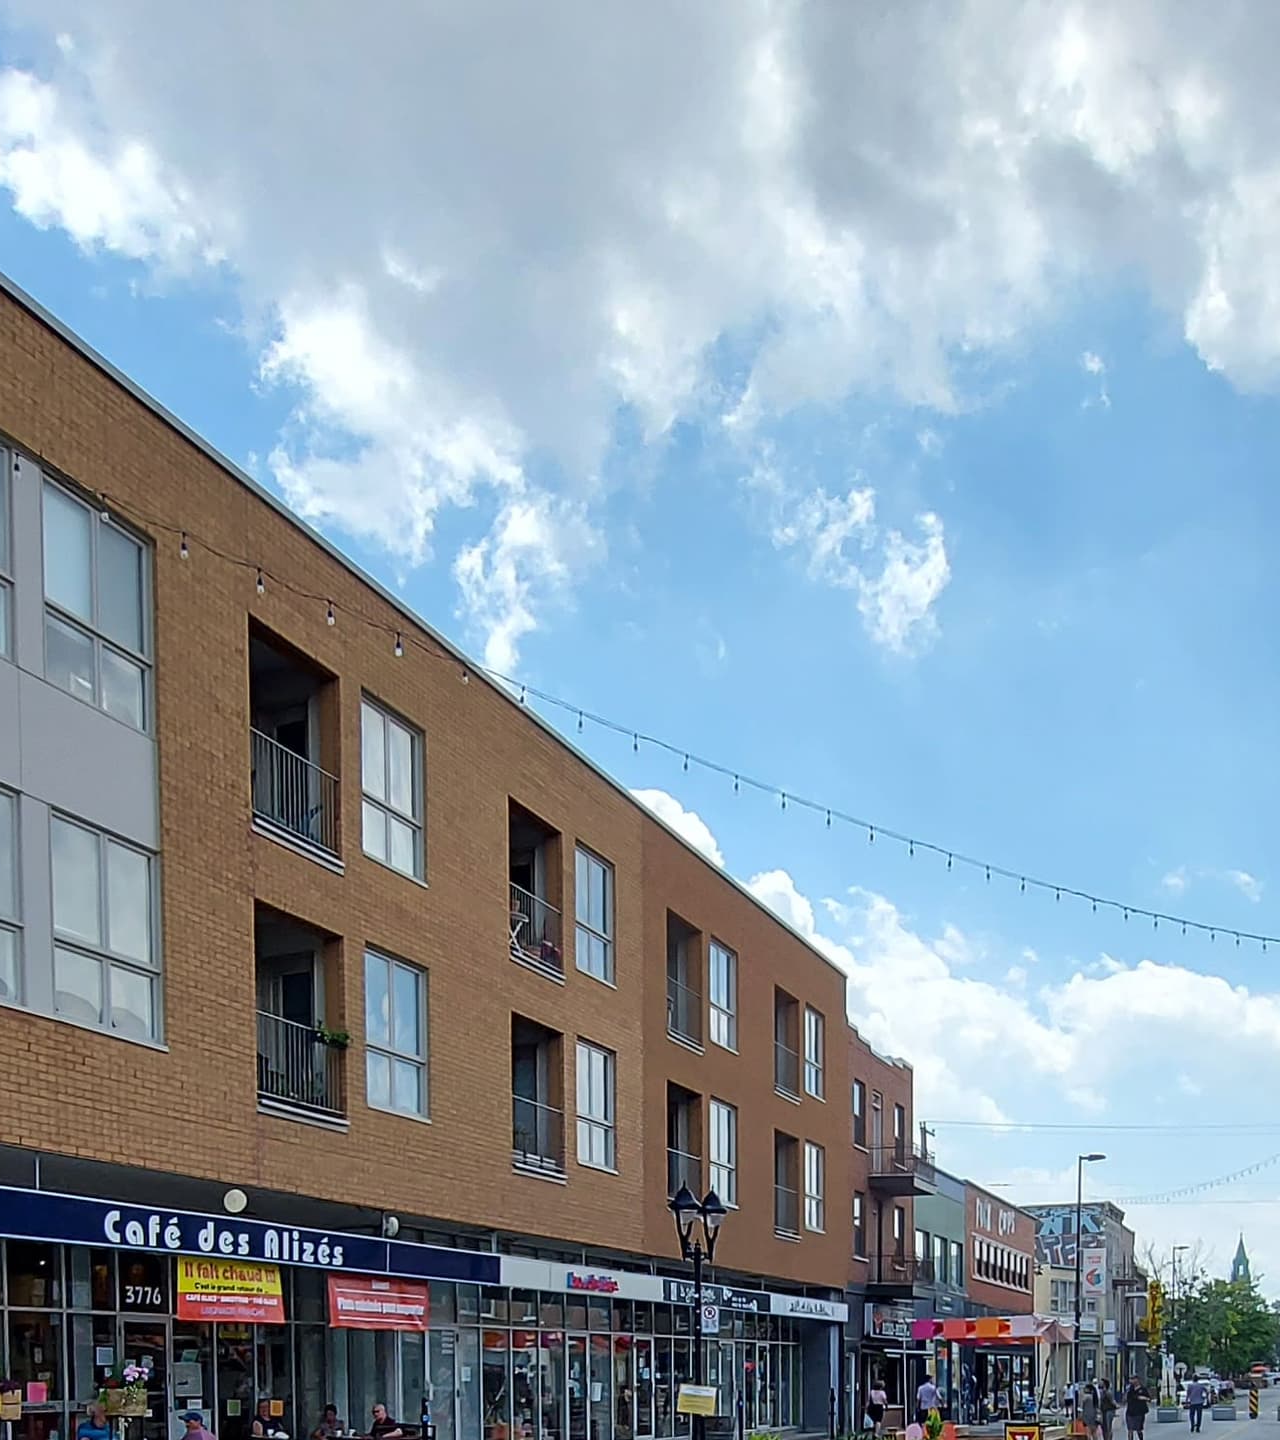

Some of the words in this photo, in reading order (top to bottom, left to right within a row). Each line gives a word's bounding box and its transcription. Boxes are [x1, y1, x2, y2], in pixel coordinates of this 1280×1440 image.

[104, 1210, 182, 1249] Café
[198, 1221, 250, 1255] des
[264, 1229, 344, 1266] Alizés
[222, 1264, 263, 1282] chaud
[125, 1285, 162, 1305] 3776
